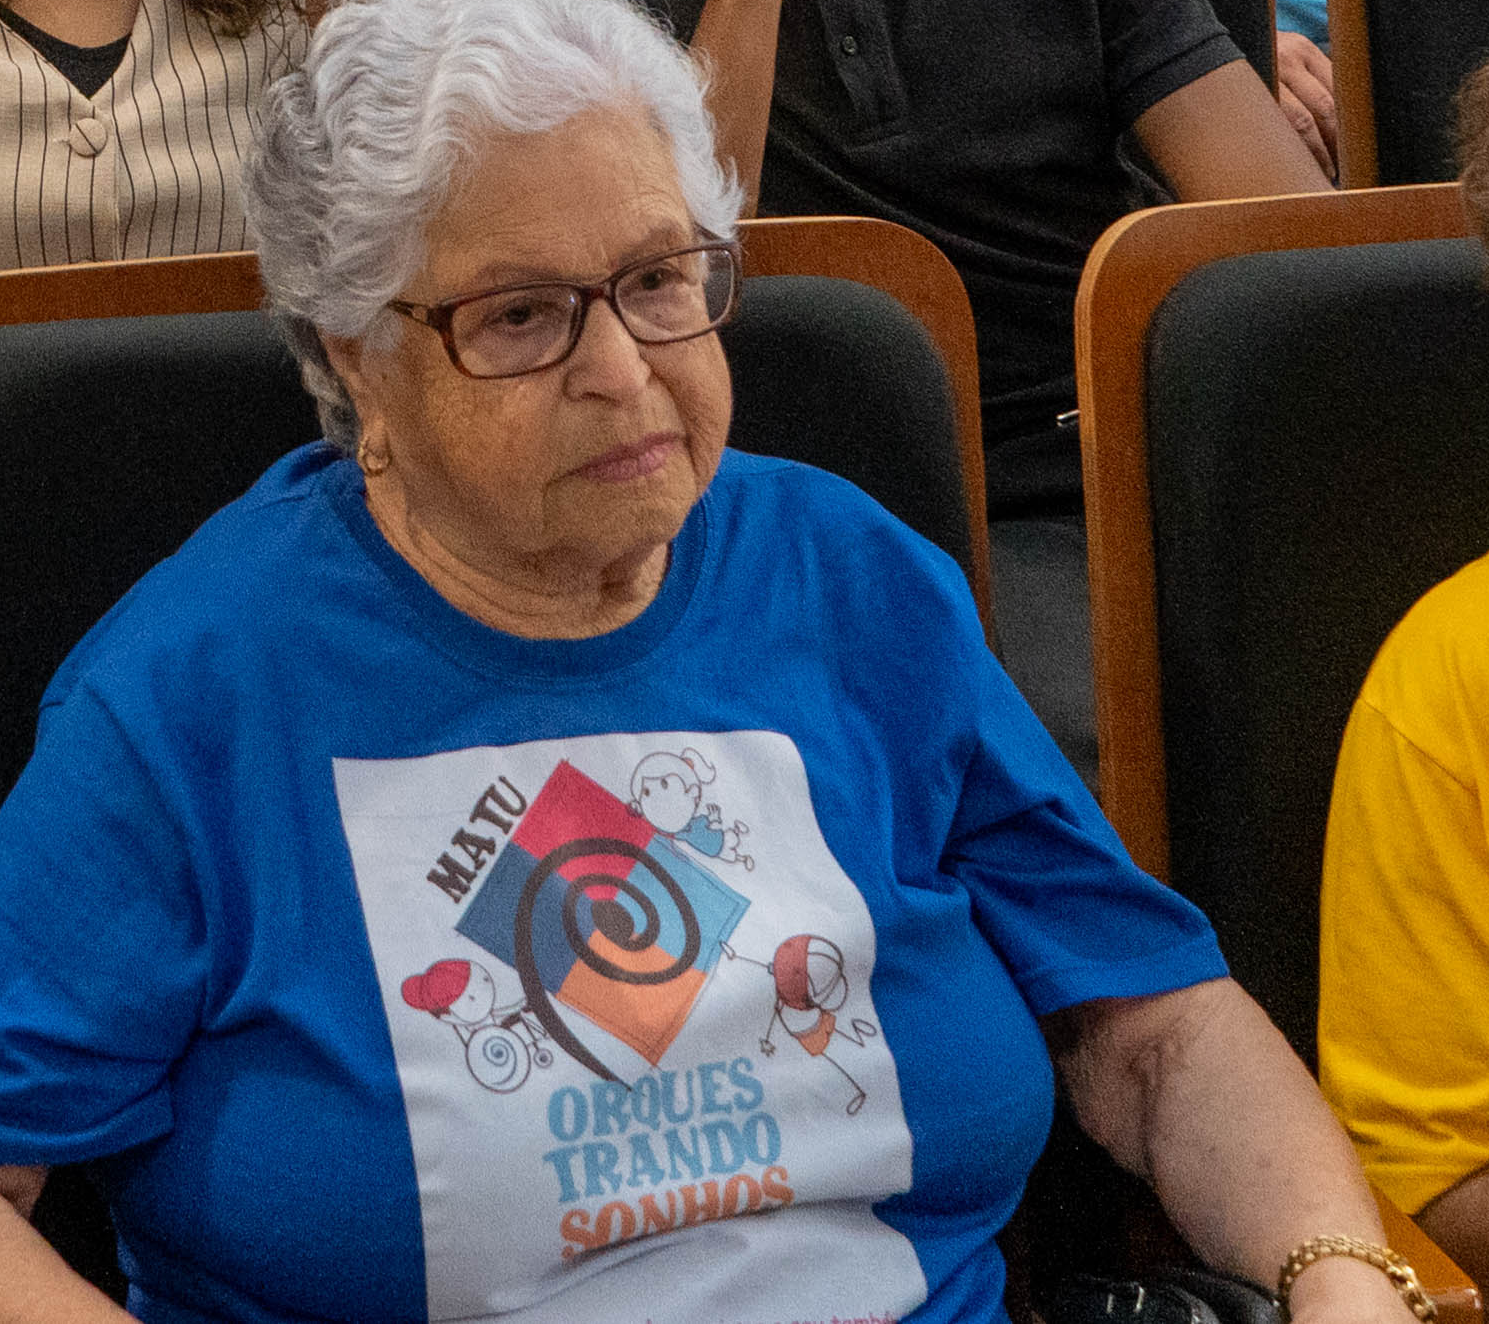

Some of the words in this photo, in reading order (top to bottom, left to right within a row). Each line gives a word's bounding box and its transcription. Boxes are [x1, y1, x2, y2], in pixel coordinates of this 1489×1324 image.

[426, 775, 527, 904] MATU
[547, 1056, 764, 1143] ORQUES
[541, 1111, 782, 1204] TRANDO
[559, 1165, 796, 1266] SONHOS
